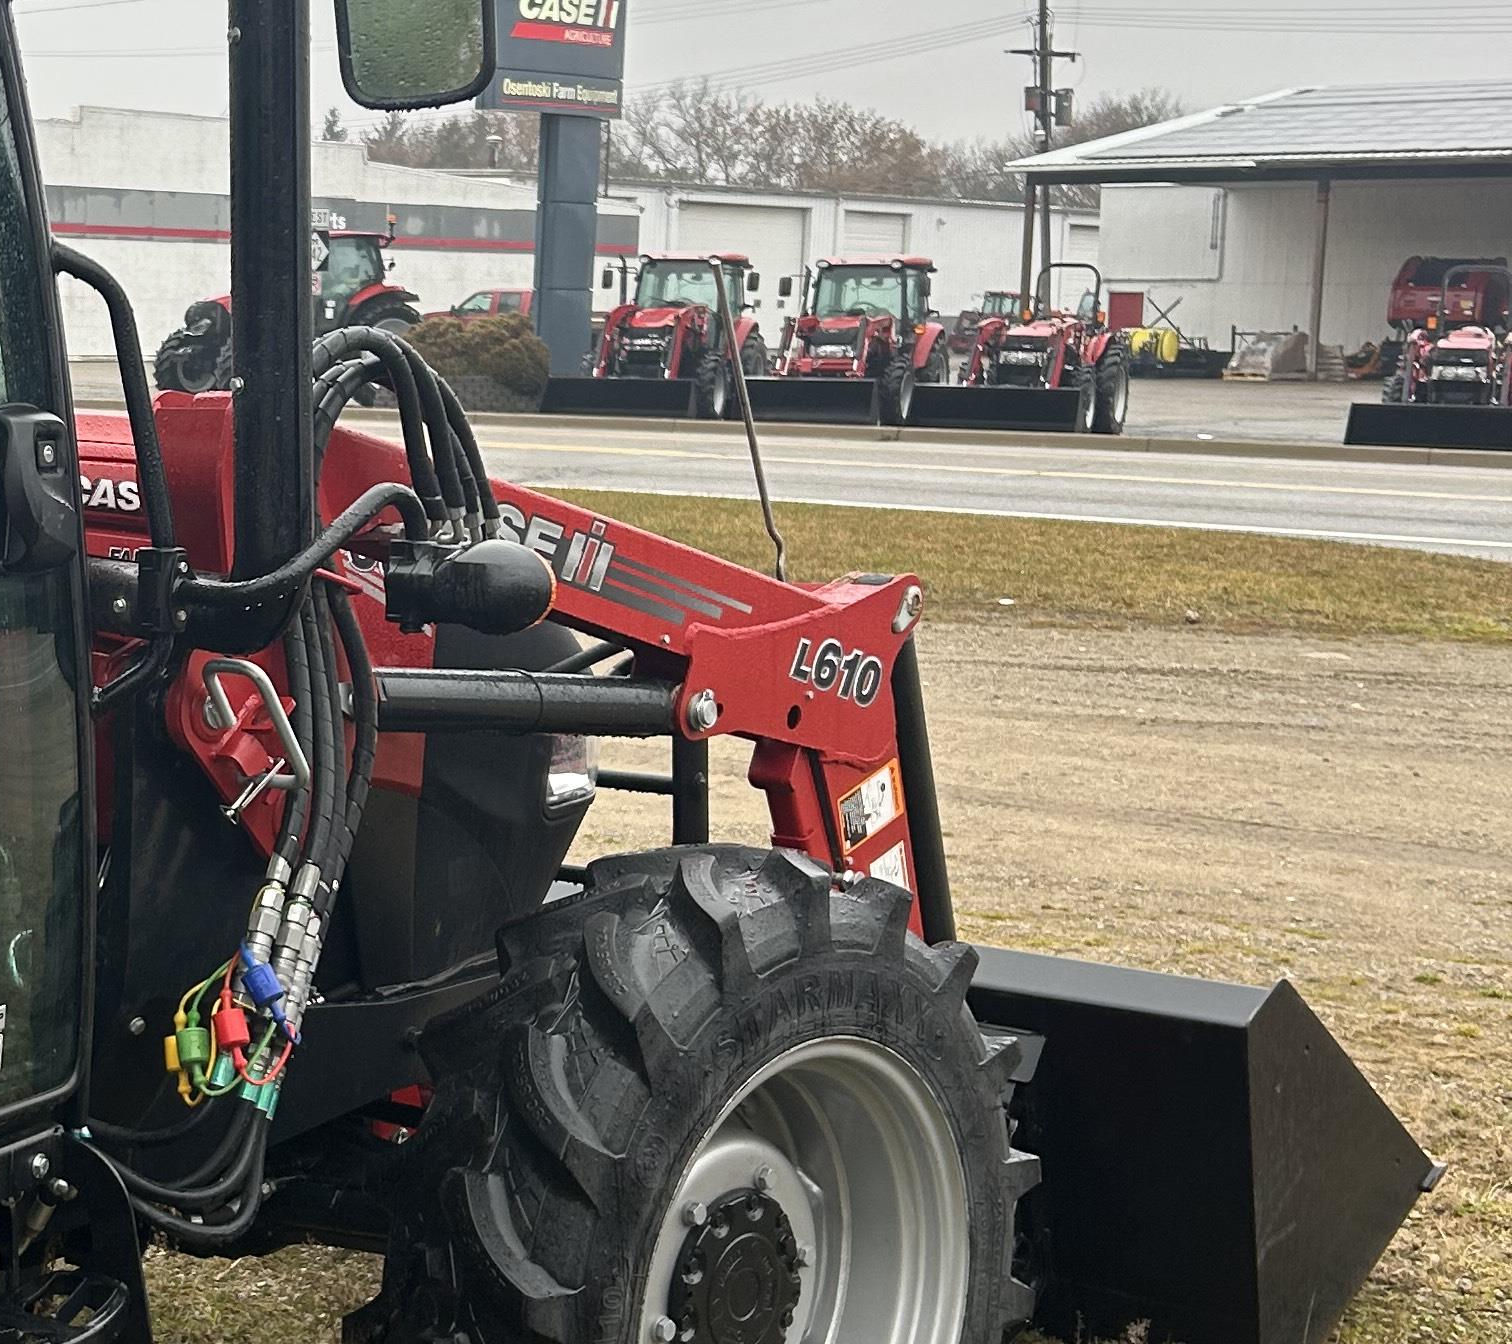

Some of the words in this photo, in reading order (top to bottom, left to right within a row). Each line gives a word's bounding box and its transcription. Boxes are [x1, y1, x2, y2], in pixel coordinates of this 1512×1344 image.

[503, 78, 551, 98] Osentoski
[552, 83, 576, 100] Farm
[576, 84, 618, 105] Equipment
[80, 475, 141, 511] CAS
[495, 503, 565, 566] SE
[789, 637, 883, 708] L610
